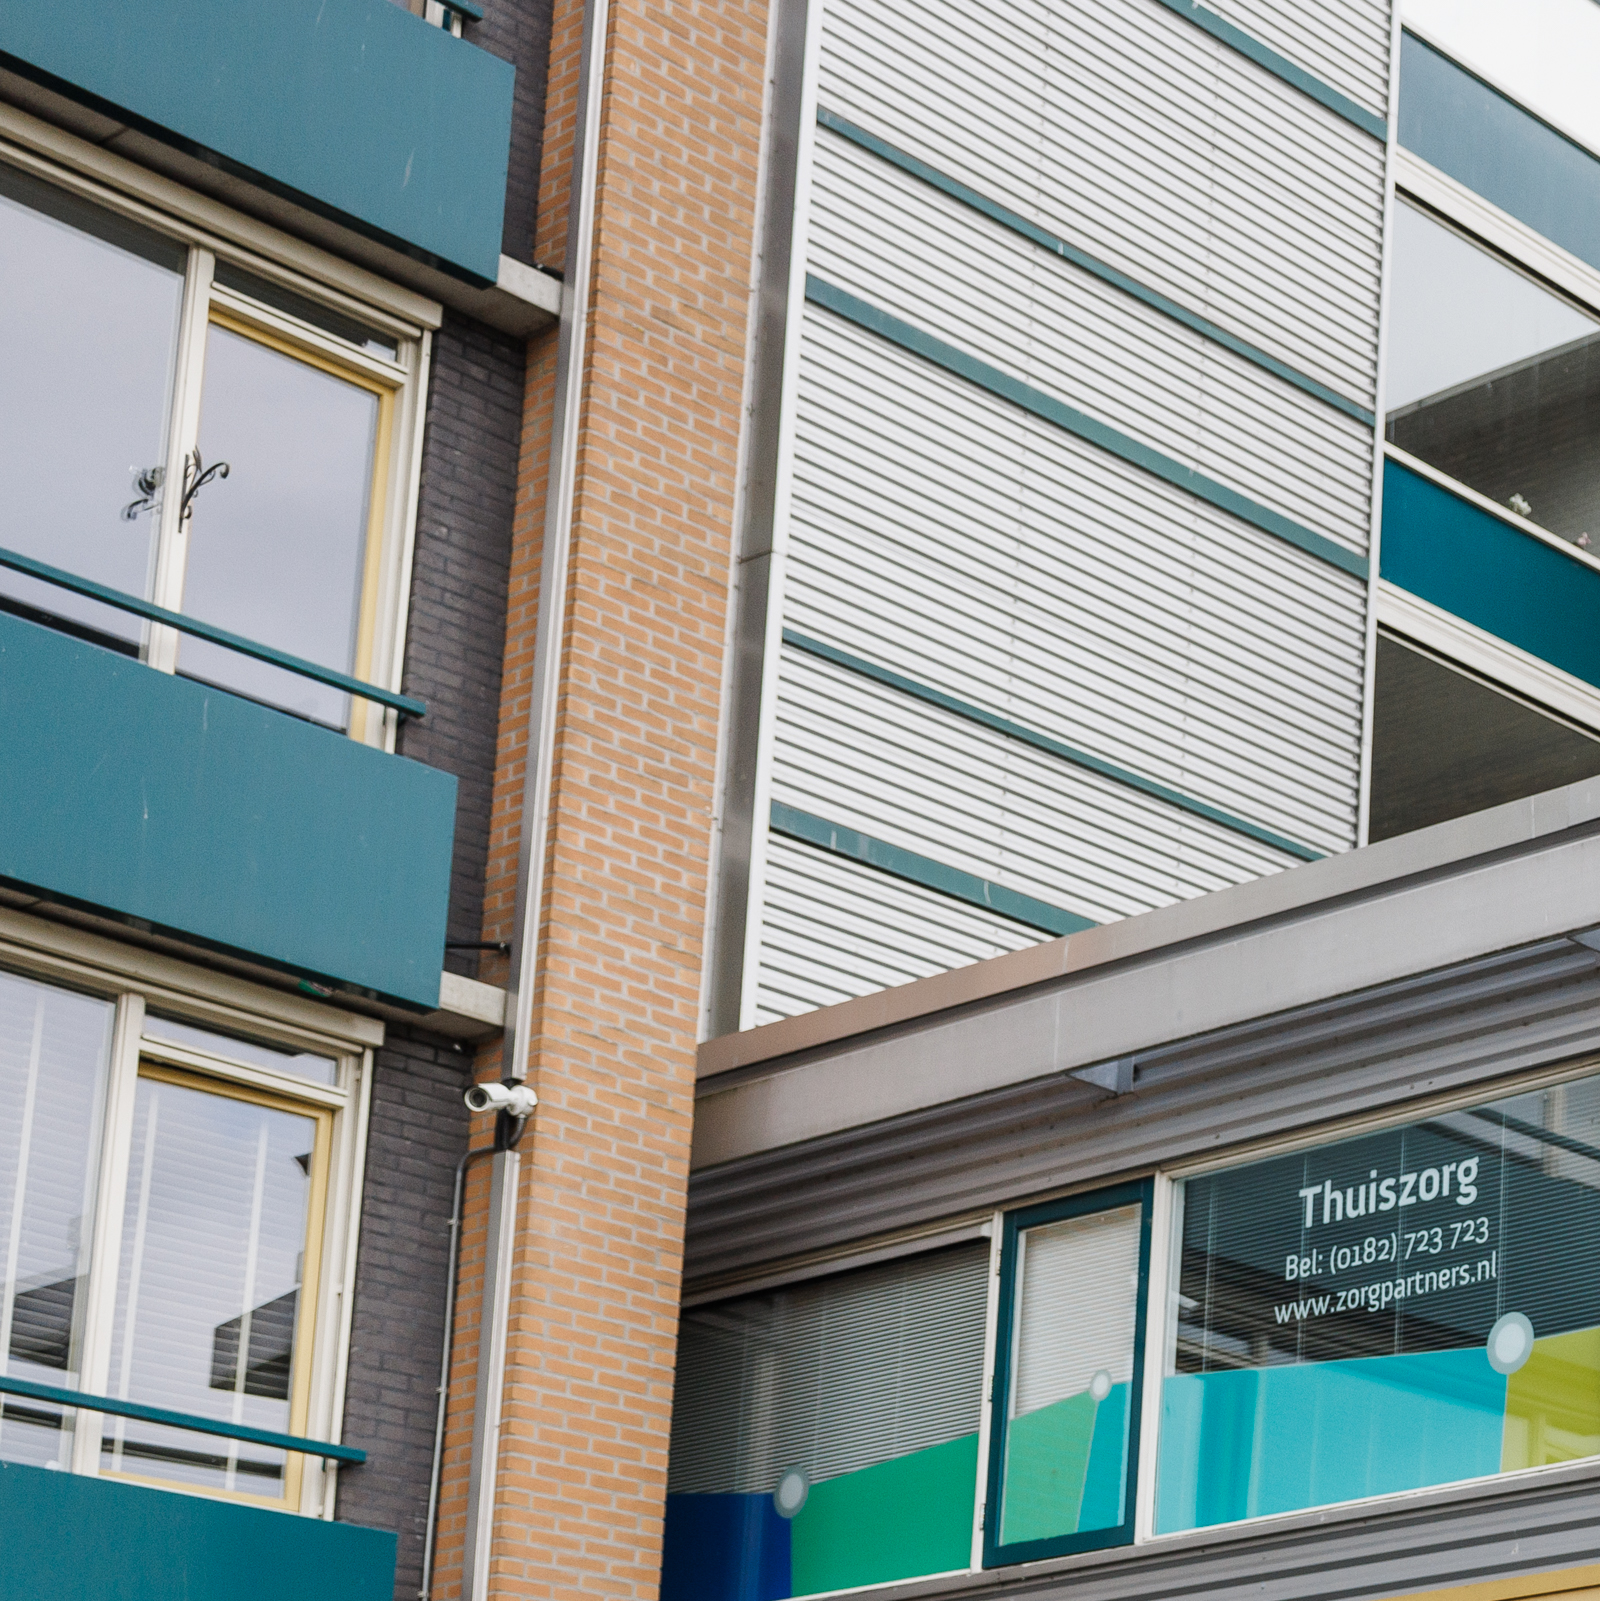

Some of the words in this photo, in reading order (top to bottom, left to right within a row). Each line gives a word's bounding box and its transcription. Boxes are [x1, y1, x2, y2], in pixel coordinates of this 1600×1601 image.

[1299, 1155, 1480, 1228] Thuiszorg
[1285, 1247, 1323, 1281] Bel:
[1329, 1232, 1397, 1276] (0182)
[1404, 1225, 1443, 1260] 723
[1450, 1215, 1489, 1247] 723
[1274, 1250, 1497, 1325] www.zorgpartners.nl
